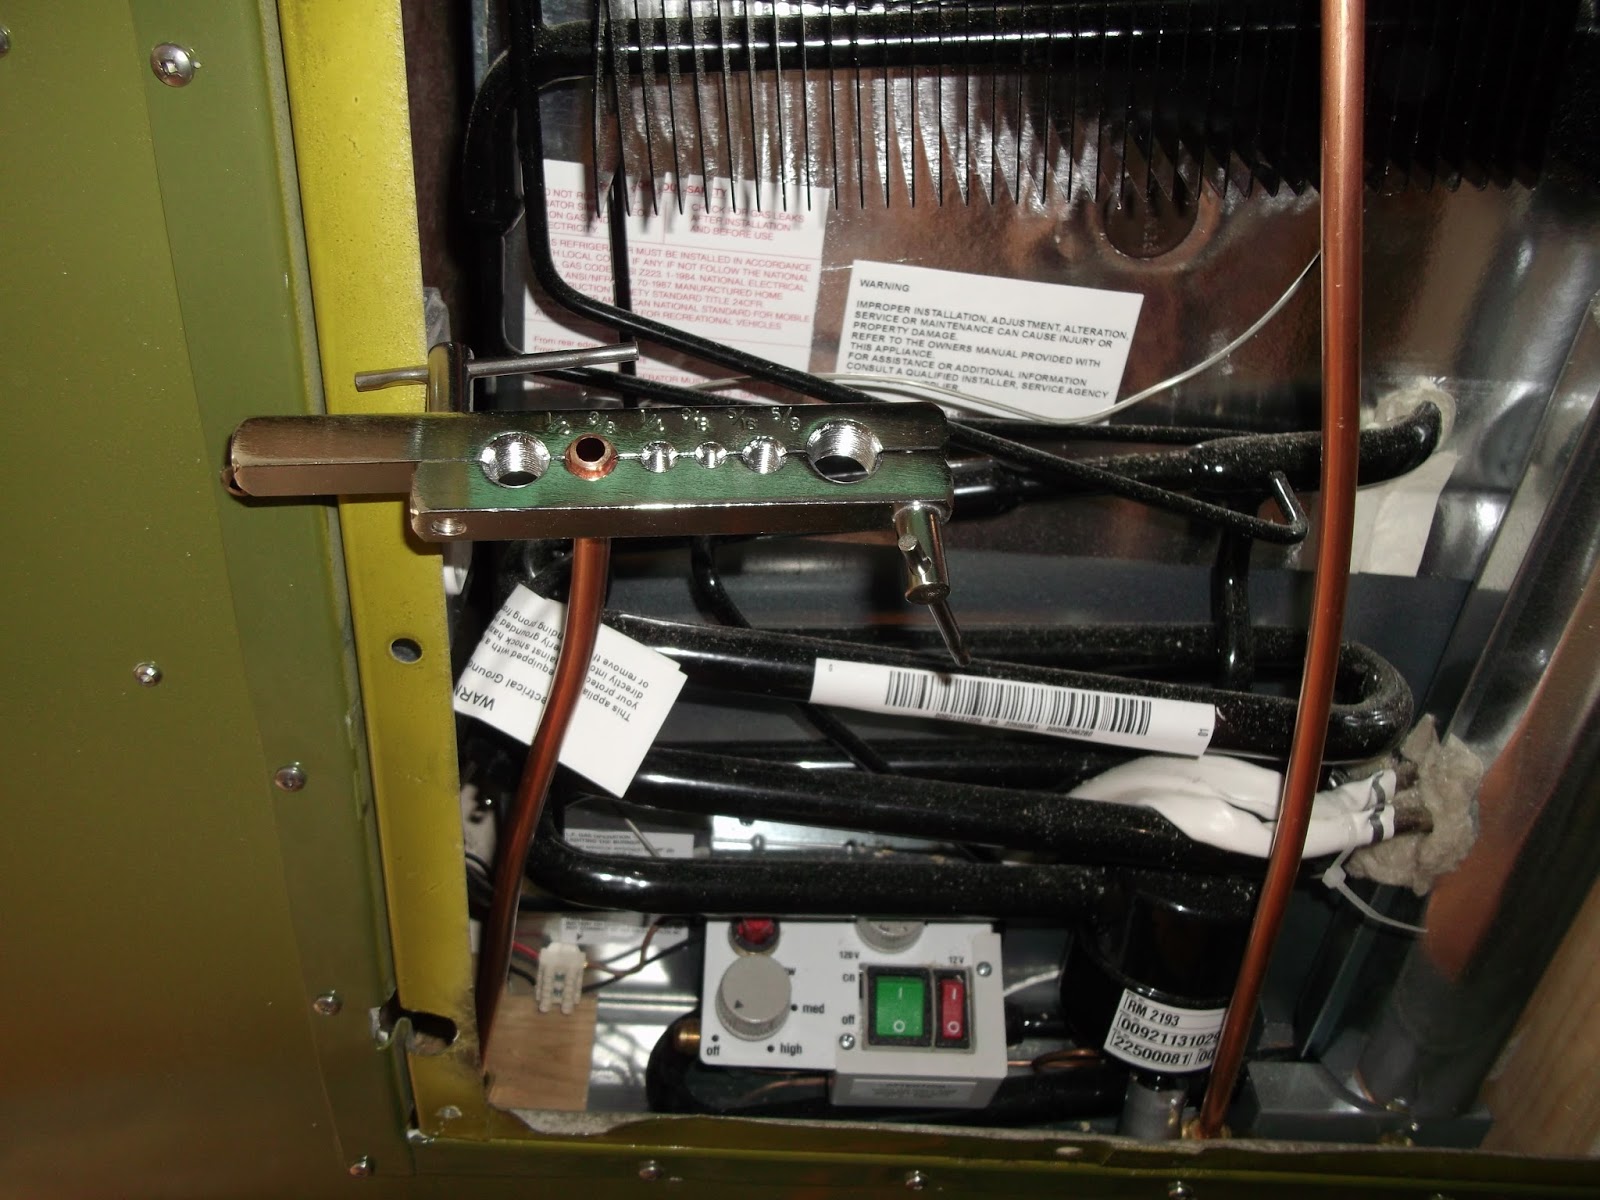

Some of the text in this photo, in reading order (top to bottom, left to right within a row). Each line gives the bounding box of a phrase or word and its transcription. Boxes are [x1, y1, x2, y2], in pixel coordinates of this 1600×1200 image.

[553, 189, 573, 198] NOT
[547, 200, 575, 210] ATOR
[566, 213, 586, 222] GAS
[691, 215, 791, 231] AFTER INSTALLATION
[751, 210, 772, 220] GAS
[773, 212, 805, 223] LEAKS
[690, 225, 774, 241] AND BEFORE USE
[562, 250, 593, 260] LOCAL
[632, 257, 640, 265] IF
[643, 259, 663, 267] ANY
[667, 260, 675, 268] IF
[677, 262, 697, 270] NOT
[700, 264, 740, 275] FOLLOW
[743, 268, 761, 277] THE
[763, 271, 809, 282] NATIONAL
[636, 247, 664, 257] MUST
[665, 249, 679, 258] BE
[680, 252, 731, 264] INSTALLED
[733, 256, 743, 265] IN
[745, 259, 812, 272] ACCORDANCE
[562, 260, 581, 269] GAS
[699, 274, 745, 286] NATIONAL
[748, 280, 805, 292] ELECTRICAL
[675, 283, 753, 296] MANUFACTURED
[754, 291, 784, 300] HOME
[859, 279, 911, 292] WARNING
[653, 290, 702, 302] STANDARD
[705, 295, 730, 305] TITLE
[732, 298, 763, 308] 24CFR
[856, 300, 911, 314] IMPROPER
[641, 309, 782, 330] FOR RECREATIONAL VEHICLES
[653, 301, 698, 313] NATIONAL
[702, 305, 751, 318] STANDARD
[753, 310, 773, 319] FOR
[775, 312, 810, 323] MOBILE
[852, 321, 959, 341] PROPERTY DAMAGE.
[854, 311, 1113, 349] SERVICE OR MAINTENANCE CAN CAUSE INJURY OR
[533, 335, 556, 345] From
[558, 339, 576, 347] rear
[850, 341, 935, 359] THIS APPLIANCE.
[851, 331, 1101, 368] REFER TO THE OWNERS MANUAL PROVIDED WITH
[847, 351, 1088, 387] FOR ASSISTANCE OR ADDITIONAL INFORMATION
[846, 361, 1110, 399] CONSULT A QUALIFIED INSTALLER, SERVICE AGENCY
[513, 610, 537, 628] prong
[500, 617, 541, 641] grounded
[491, 641, 510, 656] with
[505, 636, 531, 651] shock
[510, 649, 554, 676] equipped
[602, 658, 637, 682] remove
[590, 664, 608, 681] into
[506, 678, 548, 705] ectrical
[608, 674, 643, 700] directly
[638, 679, 649, 689] or
[582, 688, 611, 708] applia
[616, 694, 639, 711] your
[611, 704, 631, 722] This
[802, 1003, 825, 1014] med
[1127, 999, 1148, 1017] RM
[1149, 1009, 1181, 1027] 2193
[841, 1014, 856, 1025] off
[706, 1045, 720, 1056] off
[780, 1043, 802, 1057] high
